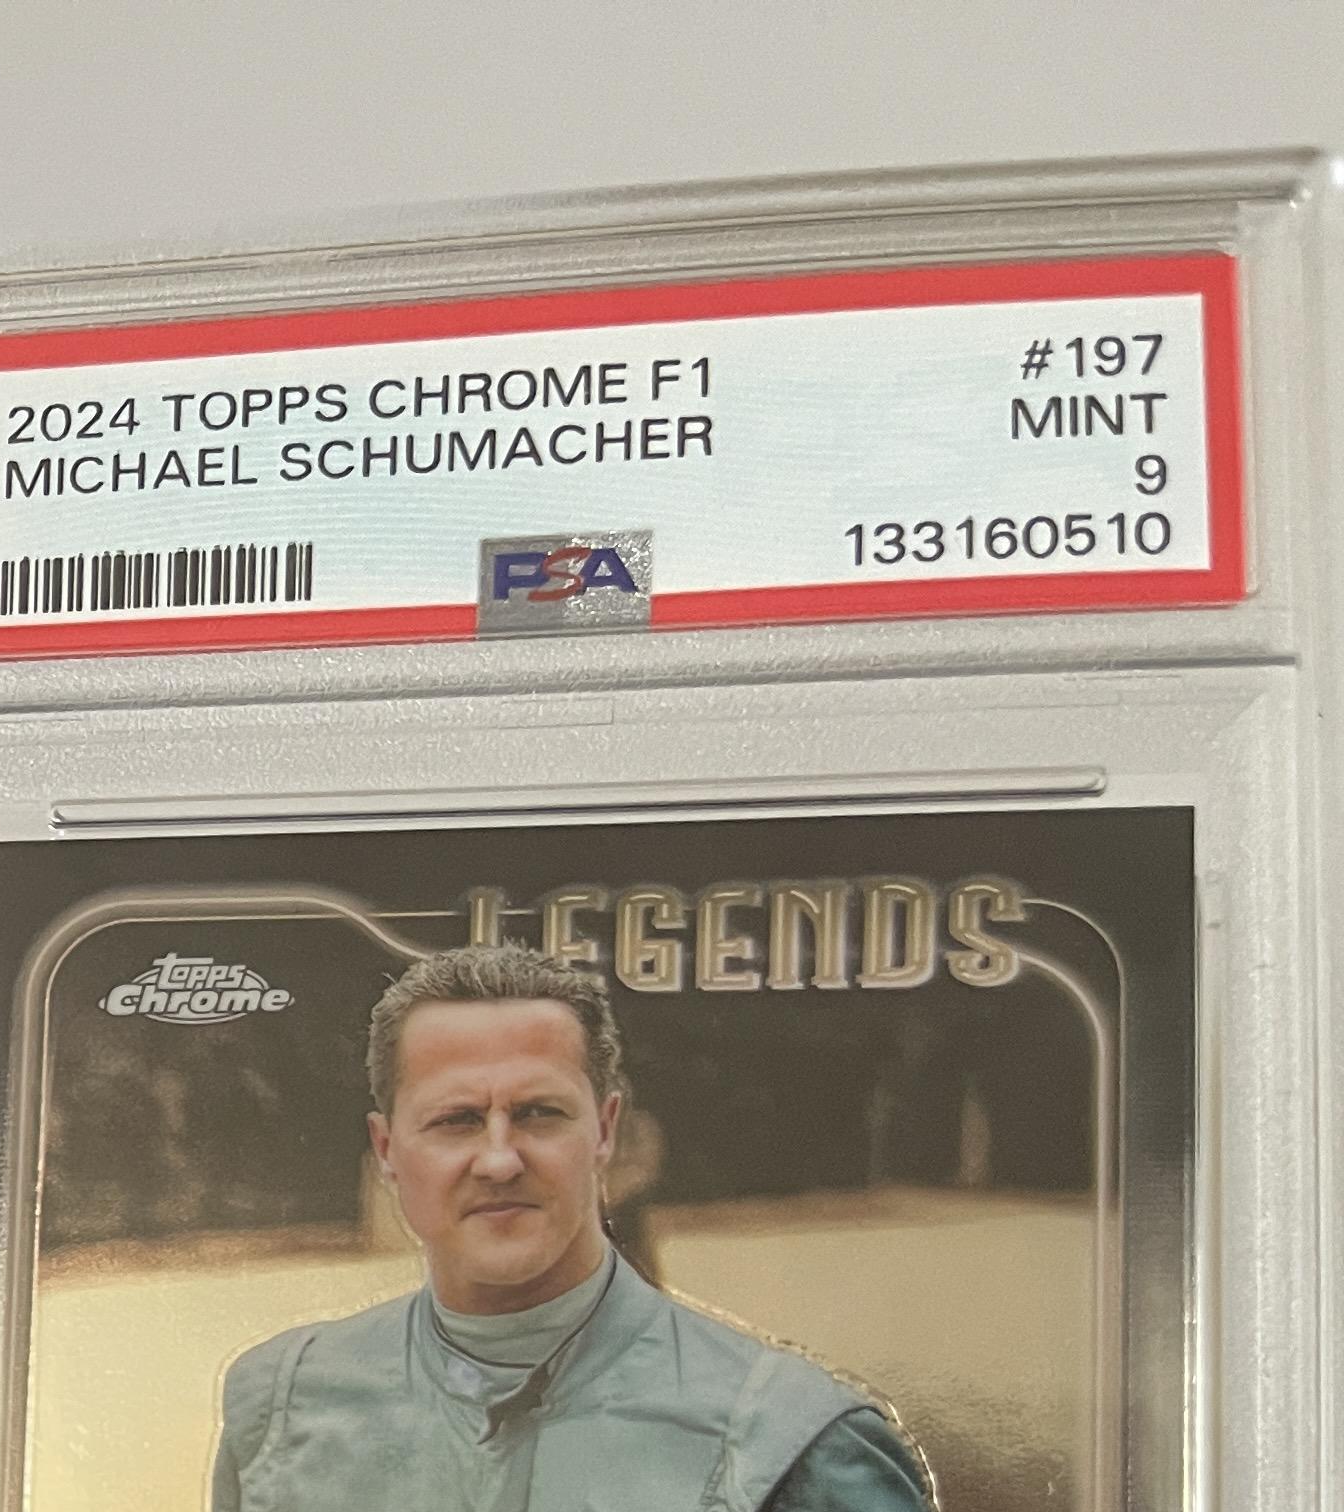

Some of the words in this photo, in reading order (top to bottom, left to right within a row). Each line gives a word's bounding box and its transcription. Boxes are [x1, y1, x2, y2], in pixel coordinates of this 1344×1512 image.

[1019, 333, 1164, 381] #197
[6, 397, 142, 446] 2024
[161, 383, 349, 433] TOPPS
[367, 362, 629, 420] CHROME
[650, 356, 710, 402] F1
[1010, 392, 1169, 441] MINT
[4, 444, 259, 500] MICHAEL
[278, 415, 714, 483] SCHUMACHER
[1133, 454, 1169, 497] 9
[843, 511, 1172, 568] 133160510
[492, 546, 639, 603] PSA
